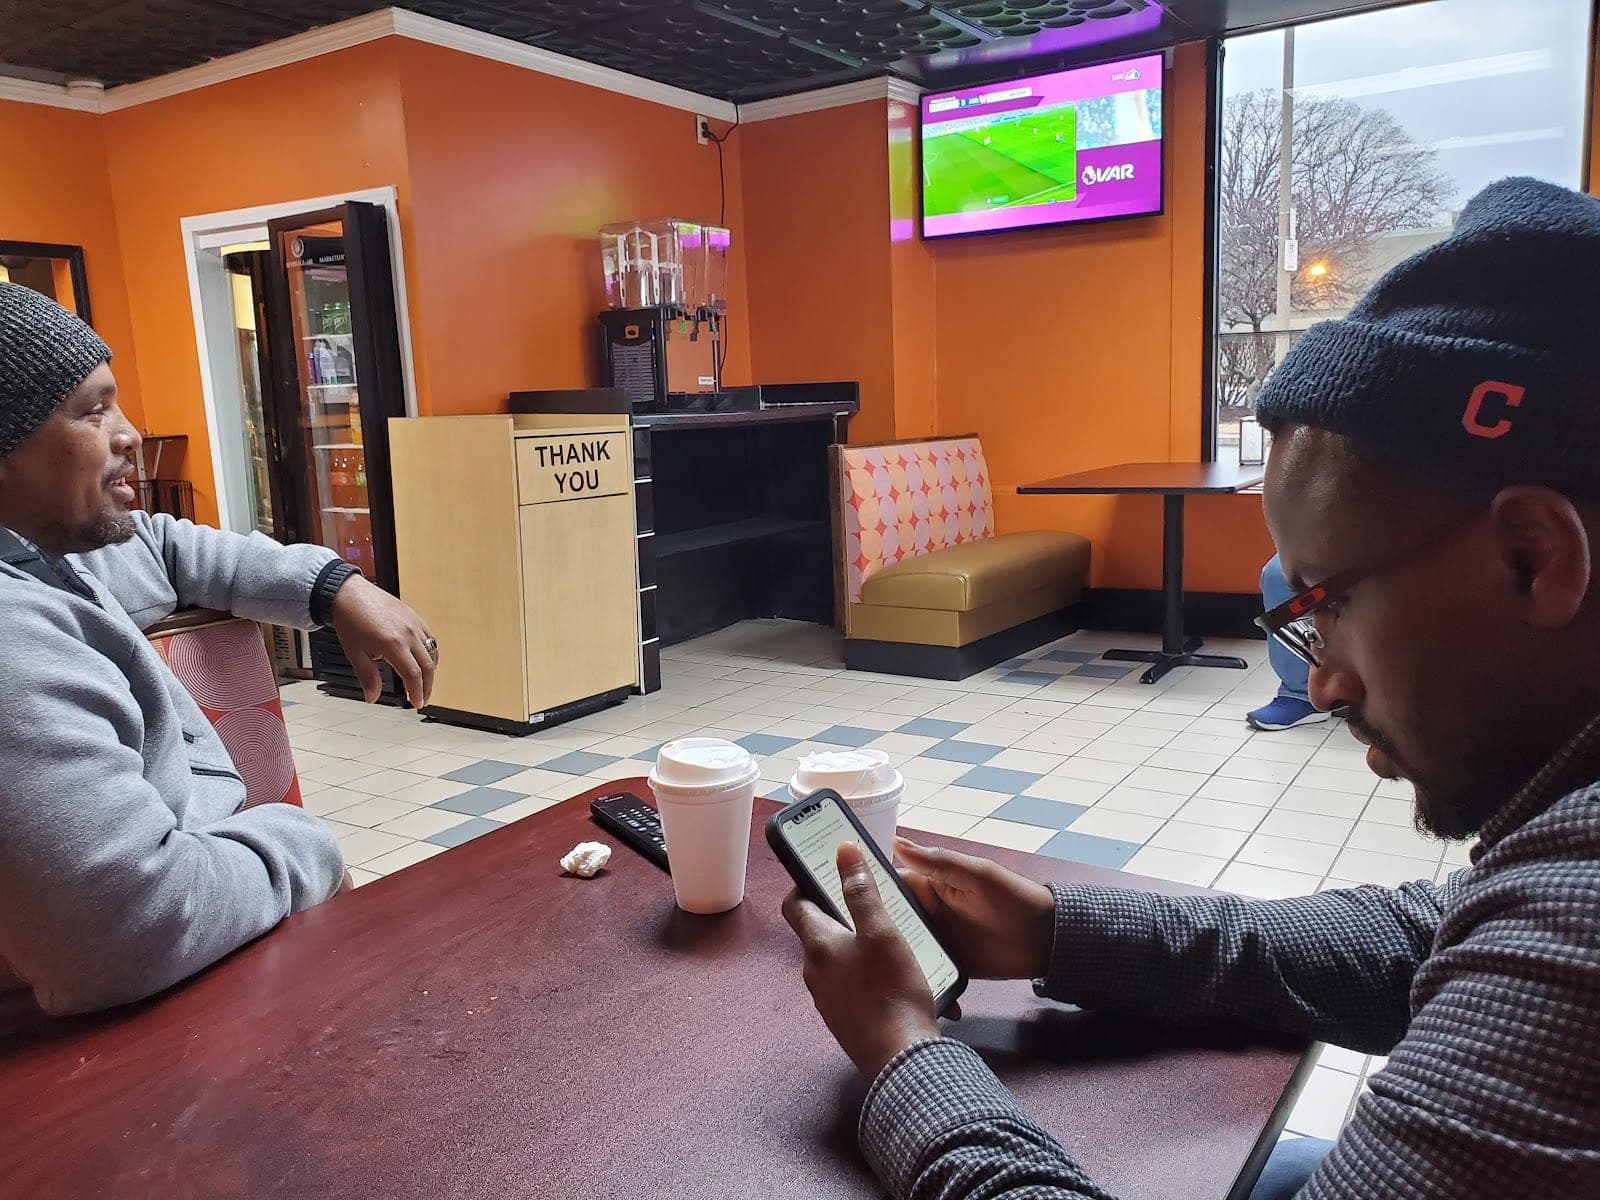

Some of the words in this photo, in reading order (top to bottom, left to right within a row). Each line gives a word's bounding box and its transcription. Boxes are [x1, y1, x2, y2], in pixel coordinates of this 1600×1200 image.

[1096, 163, 1135, 182] VAR
[1462, 380, 1526, 439] C
[534, 440, 611, 467] THANK
[554, 469, 599, 494] YOU
